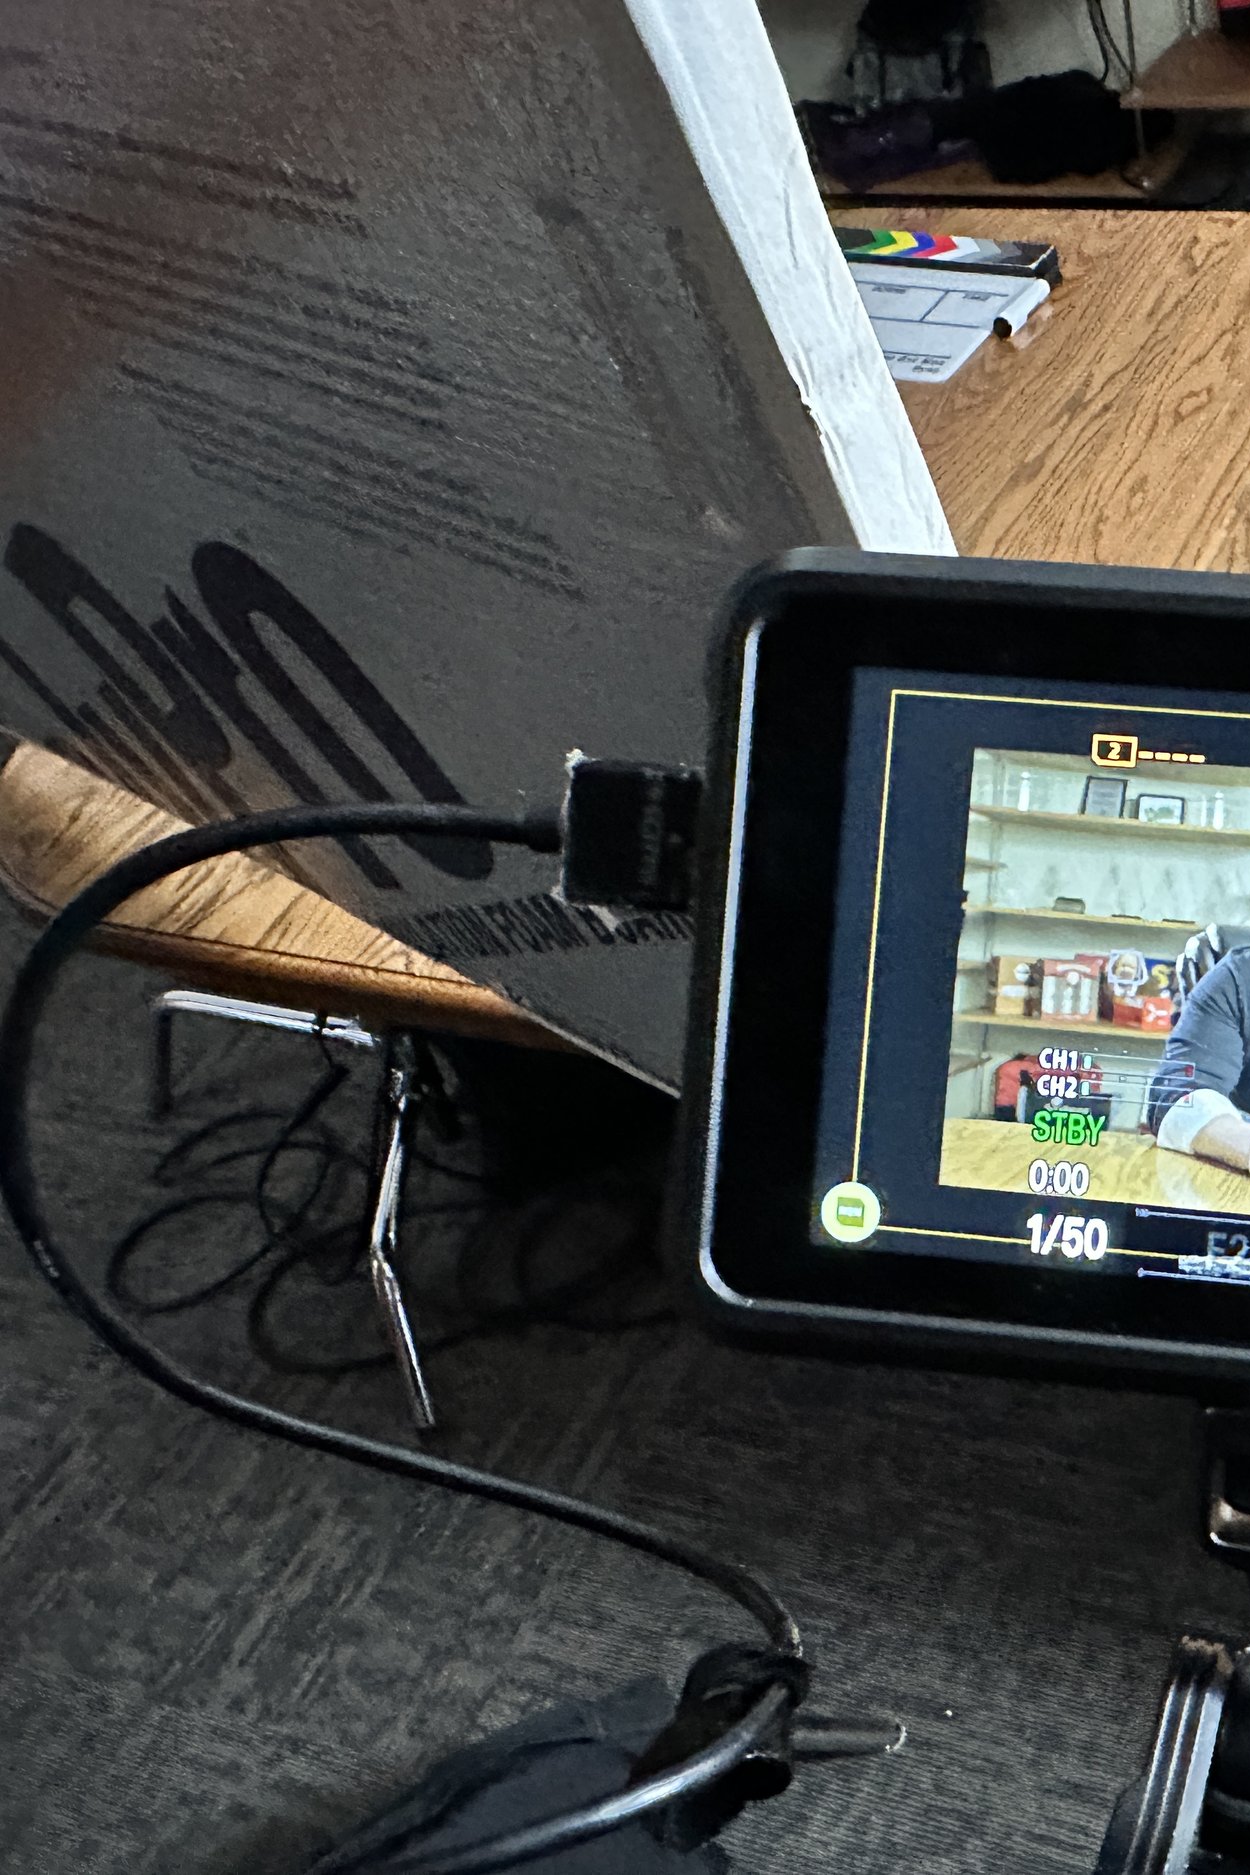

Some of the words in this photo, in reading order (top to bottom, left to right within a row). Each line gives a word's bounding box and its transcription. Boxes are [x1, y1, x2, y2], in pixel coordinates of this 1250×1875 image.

[1039, 1047, 1078, 1071] CH1
[1037, 1075, 1078, 1099] CH2
[1032, 1110, 1106, 1146] STBY
[1029, 1159, 1090, 1196] 0:00
[1027, 1213, 1109, 1260] 1/50
